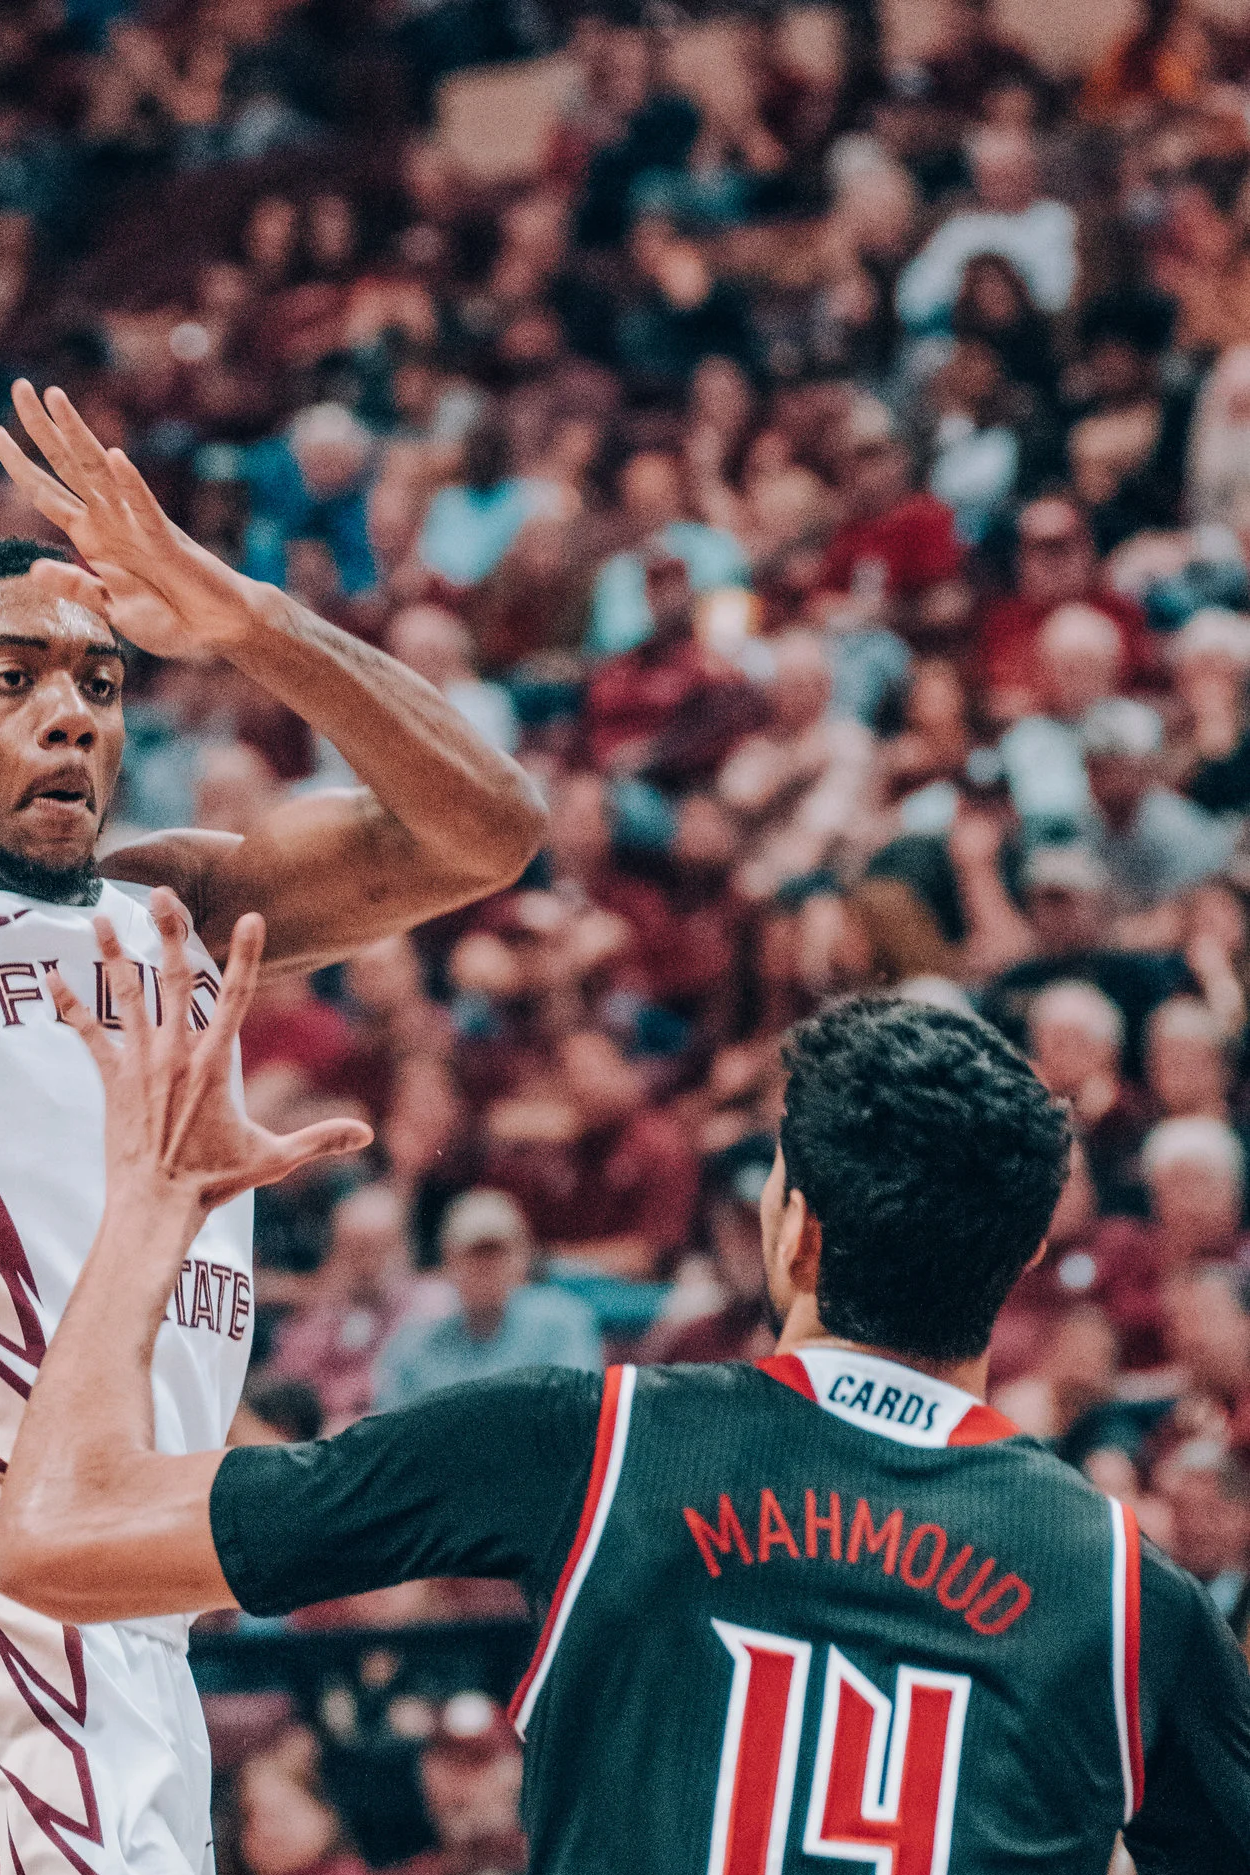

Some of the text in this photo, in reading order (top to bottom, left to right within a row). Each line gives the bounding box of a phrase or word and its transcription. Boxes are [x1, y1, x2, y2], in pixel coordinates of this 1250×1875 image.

[163, 1259, 250, 1340] TATE
[828, 1375, 938, 1430] CARDS
[684, 1489, 1032, 1635] MAHMOUD
